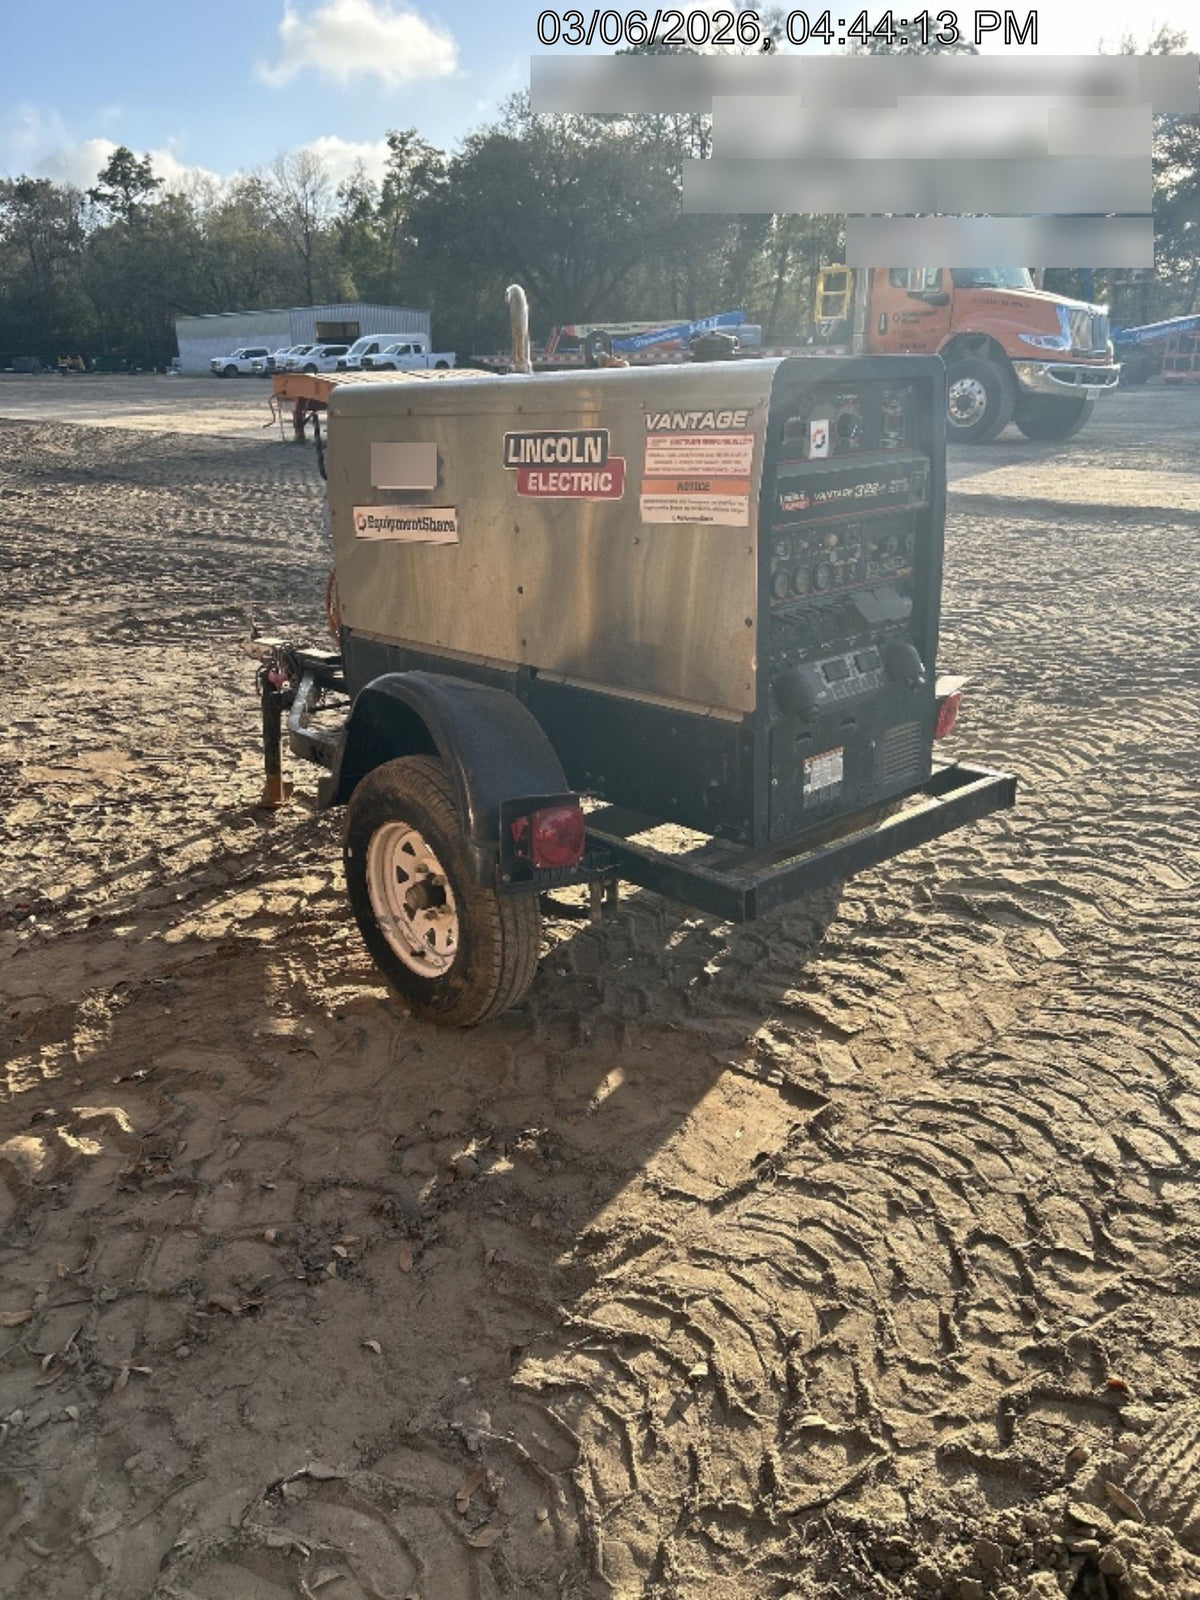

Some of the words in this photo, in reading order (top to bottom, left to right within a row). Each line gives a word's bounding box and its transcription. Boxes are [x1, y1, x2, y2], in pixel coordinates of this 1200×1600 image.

[645, 410, 749, 430] VANTAGE
[507, 436, 602, 463] LINCOLN
[527, 472, 613, 492] ELECTRIC
[367, 514, 456, 533] EquipmentShare
